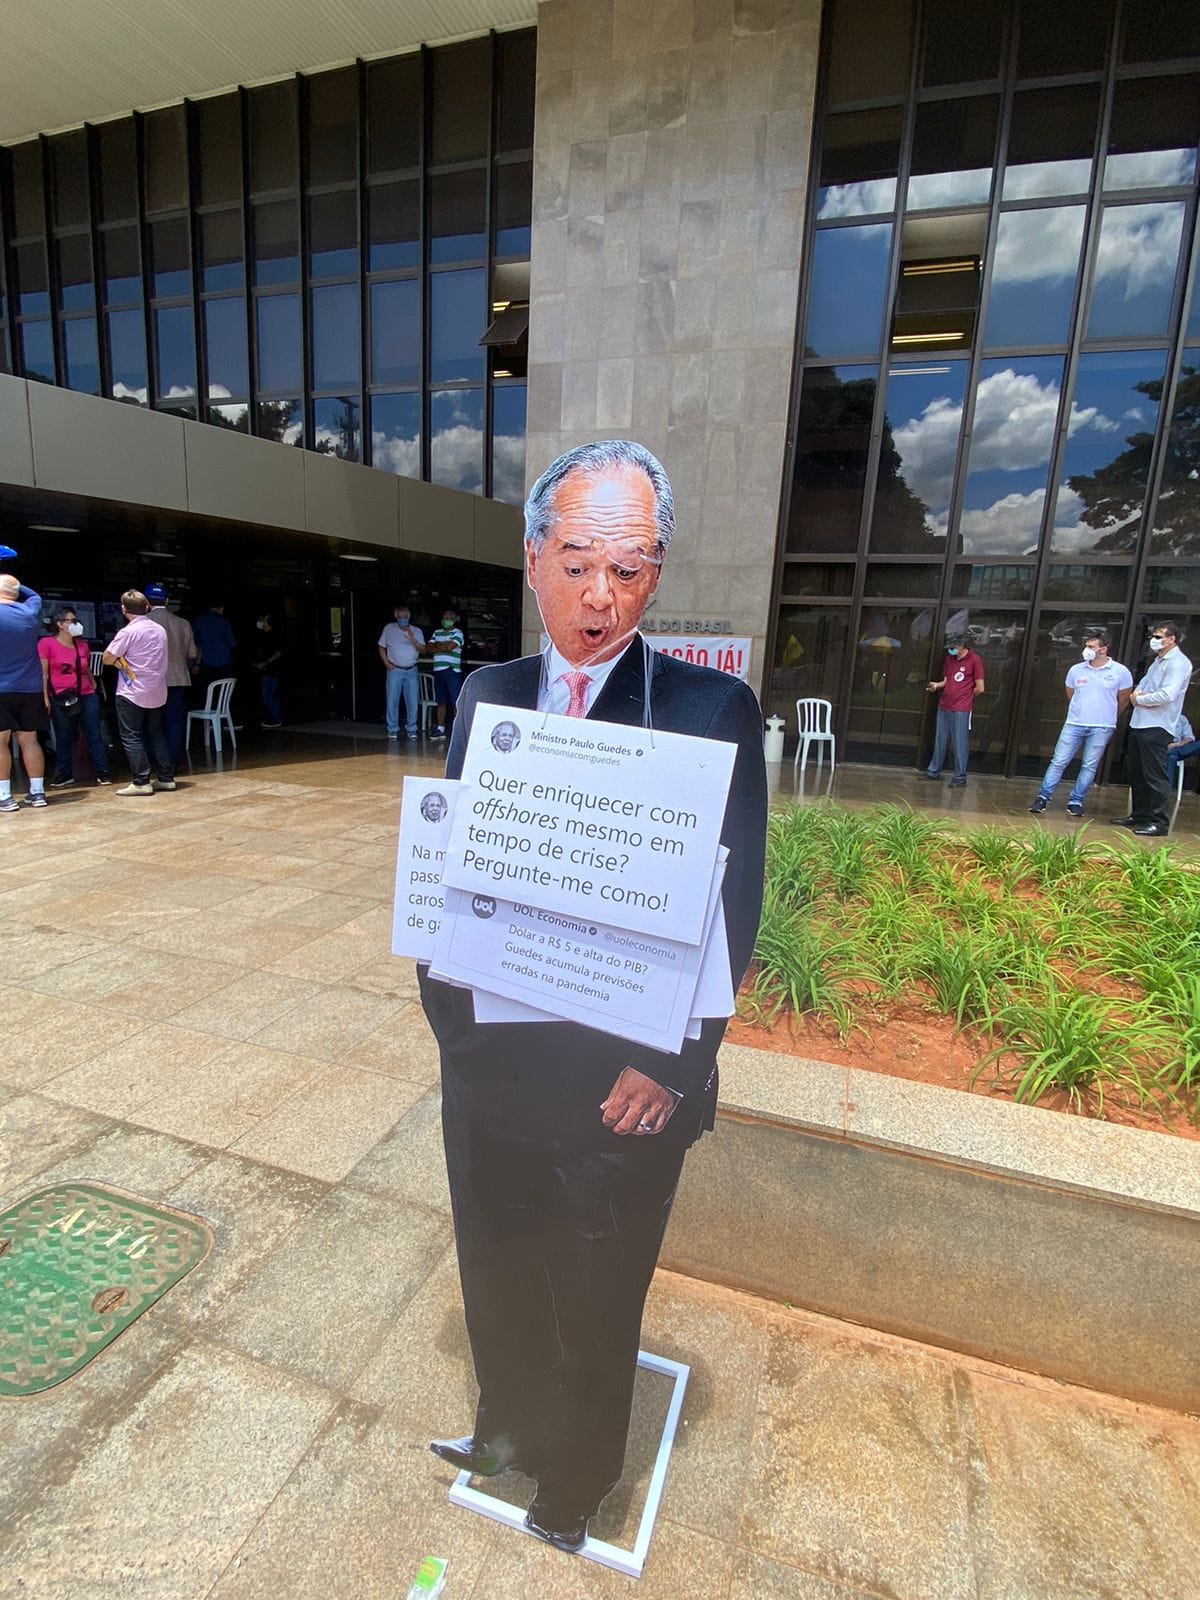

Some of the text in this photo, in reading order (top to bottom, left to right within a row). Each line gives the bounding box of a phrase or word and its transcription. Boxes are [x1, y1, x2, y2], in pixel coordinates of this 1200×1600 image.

[660, 619, 680, 632] DO
[684, 620, 735, 634] BRASIL
[528, 743, 621, 767] @economiacomguedes
[531, 731, 632, 756] Ministro Paulo Guedes
[478, 770, 697, 829] Quer enriquecer com
[468, 824, 630, 873] tempo de crise?
[472, 798, 684, 856] offshores mesmo em
[412, 844, 431, 860] Na
[410, 870, 441, 885] pass
[463, 849, 669, 912] Pergunte-me como!
[407, 913, 424, 928] de
[408, 893, 444, 908] caros
[508, 923, 649, 976] Dólar a R$ 5 e alta do PIB?
[513, 903, 677, 960] UOL Economia @uoleconomia
[501, 959, 611, 1002] erradas na pandemia
[504, 941, 645, 994] Guedes acumula previsões
